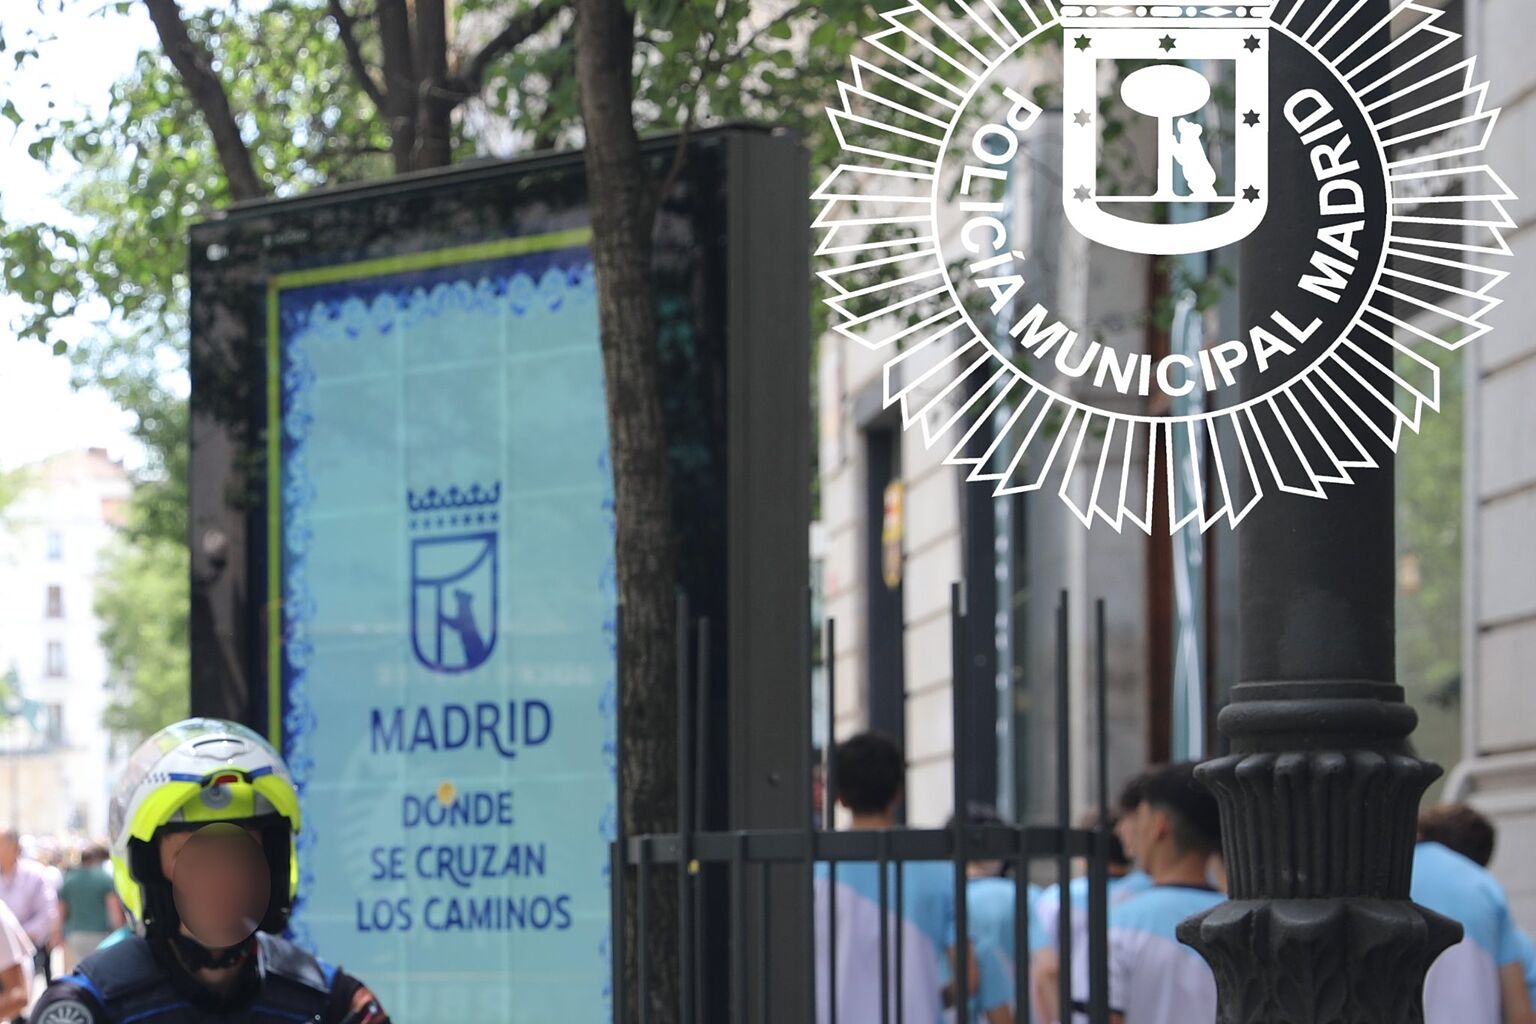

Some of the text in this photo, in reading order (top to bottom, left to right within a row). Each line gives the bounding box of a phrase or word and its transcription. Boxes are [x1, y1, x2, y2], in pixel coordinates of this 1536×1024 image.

[369, 700, 552, 760] MADRID
[370, 843, 546, 888] SE CRUZAN
[357, 895, 572, 932] LOS CAMINOS
